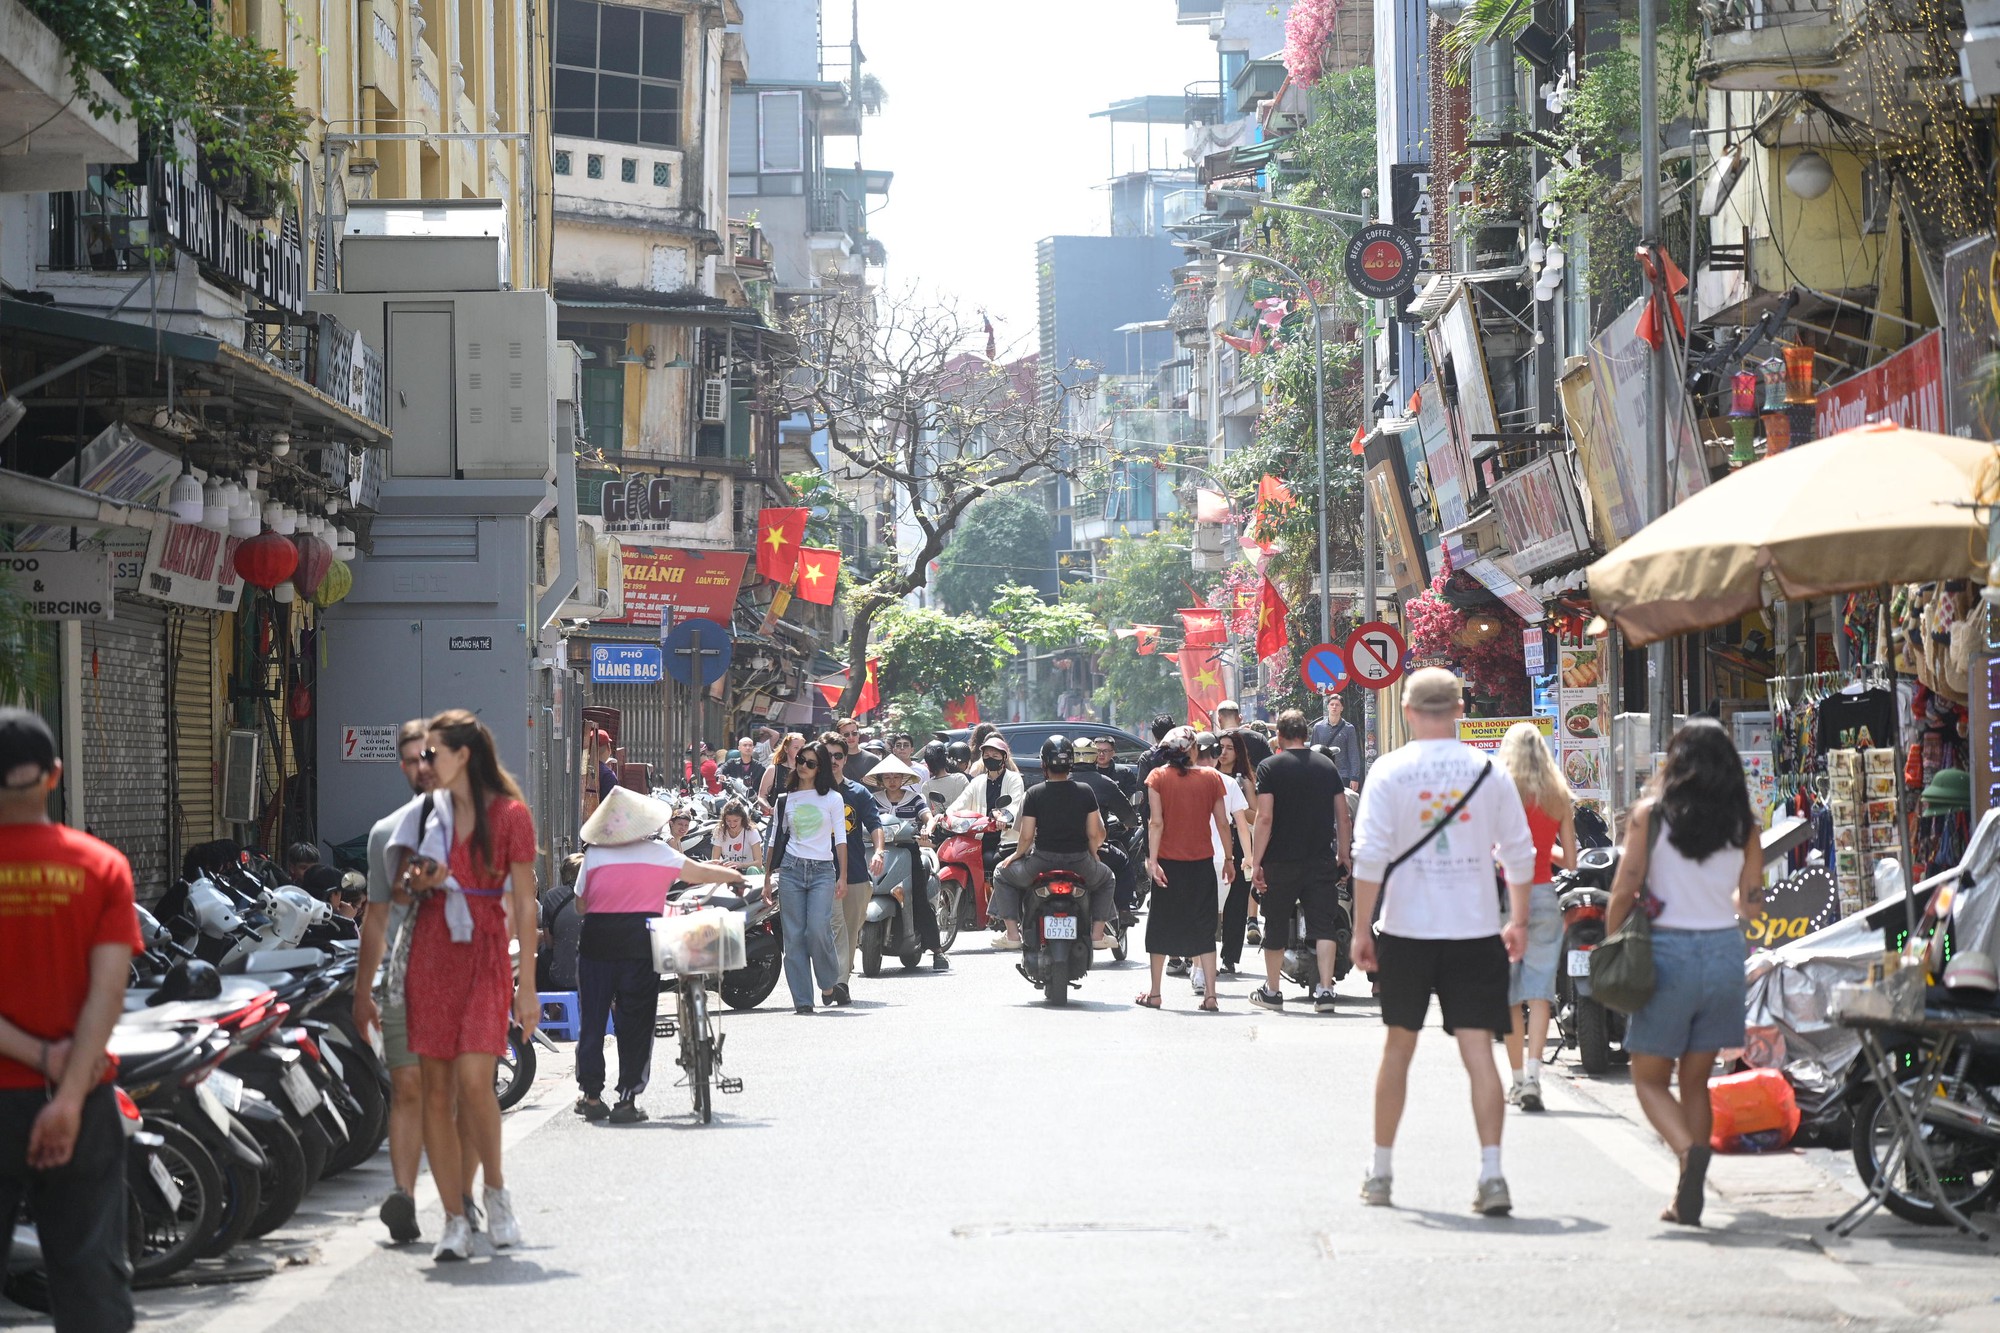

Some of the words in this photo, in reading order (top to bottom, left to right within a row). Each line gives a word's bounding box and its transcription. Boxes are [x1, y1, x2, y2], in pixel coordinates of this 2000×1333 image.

[1350, 240, 1363, 260] BEER
[1365, 229, 1391, 240] COFFEE
[1395, 235, 1414, 260] CUSINE
[262, 225, 303, 317] STUDIO
[1387, 260, 1401, 268] 26
[622, 561, 686, 583] KHÁNH
[33, 579, 45, 593] &
[695, 576, 712, 584] LOAN
[22, 601, 102, 615] PIERCING
[620, 648, 643, 658] PHỐ
[597, 660, 631, 677] HÀNG
[633, 663, 658, 680] BẠC
[1474, 741, 1495, 749] LONG
[1050, 918, 1072, 928] 29-C2
[1745, 911, 1810, 947] Spa
[1046, 928, 1075, 938] 057.62
